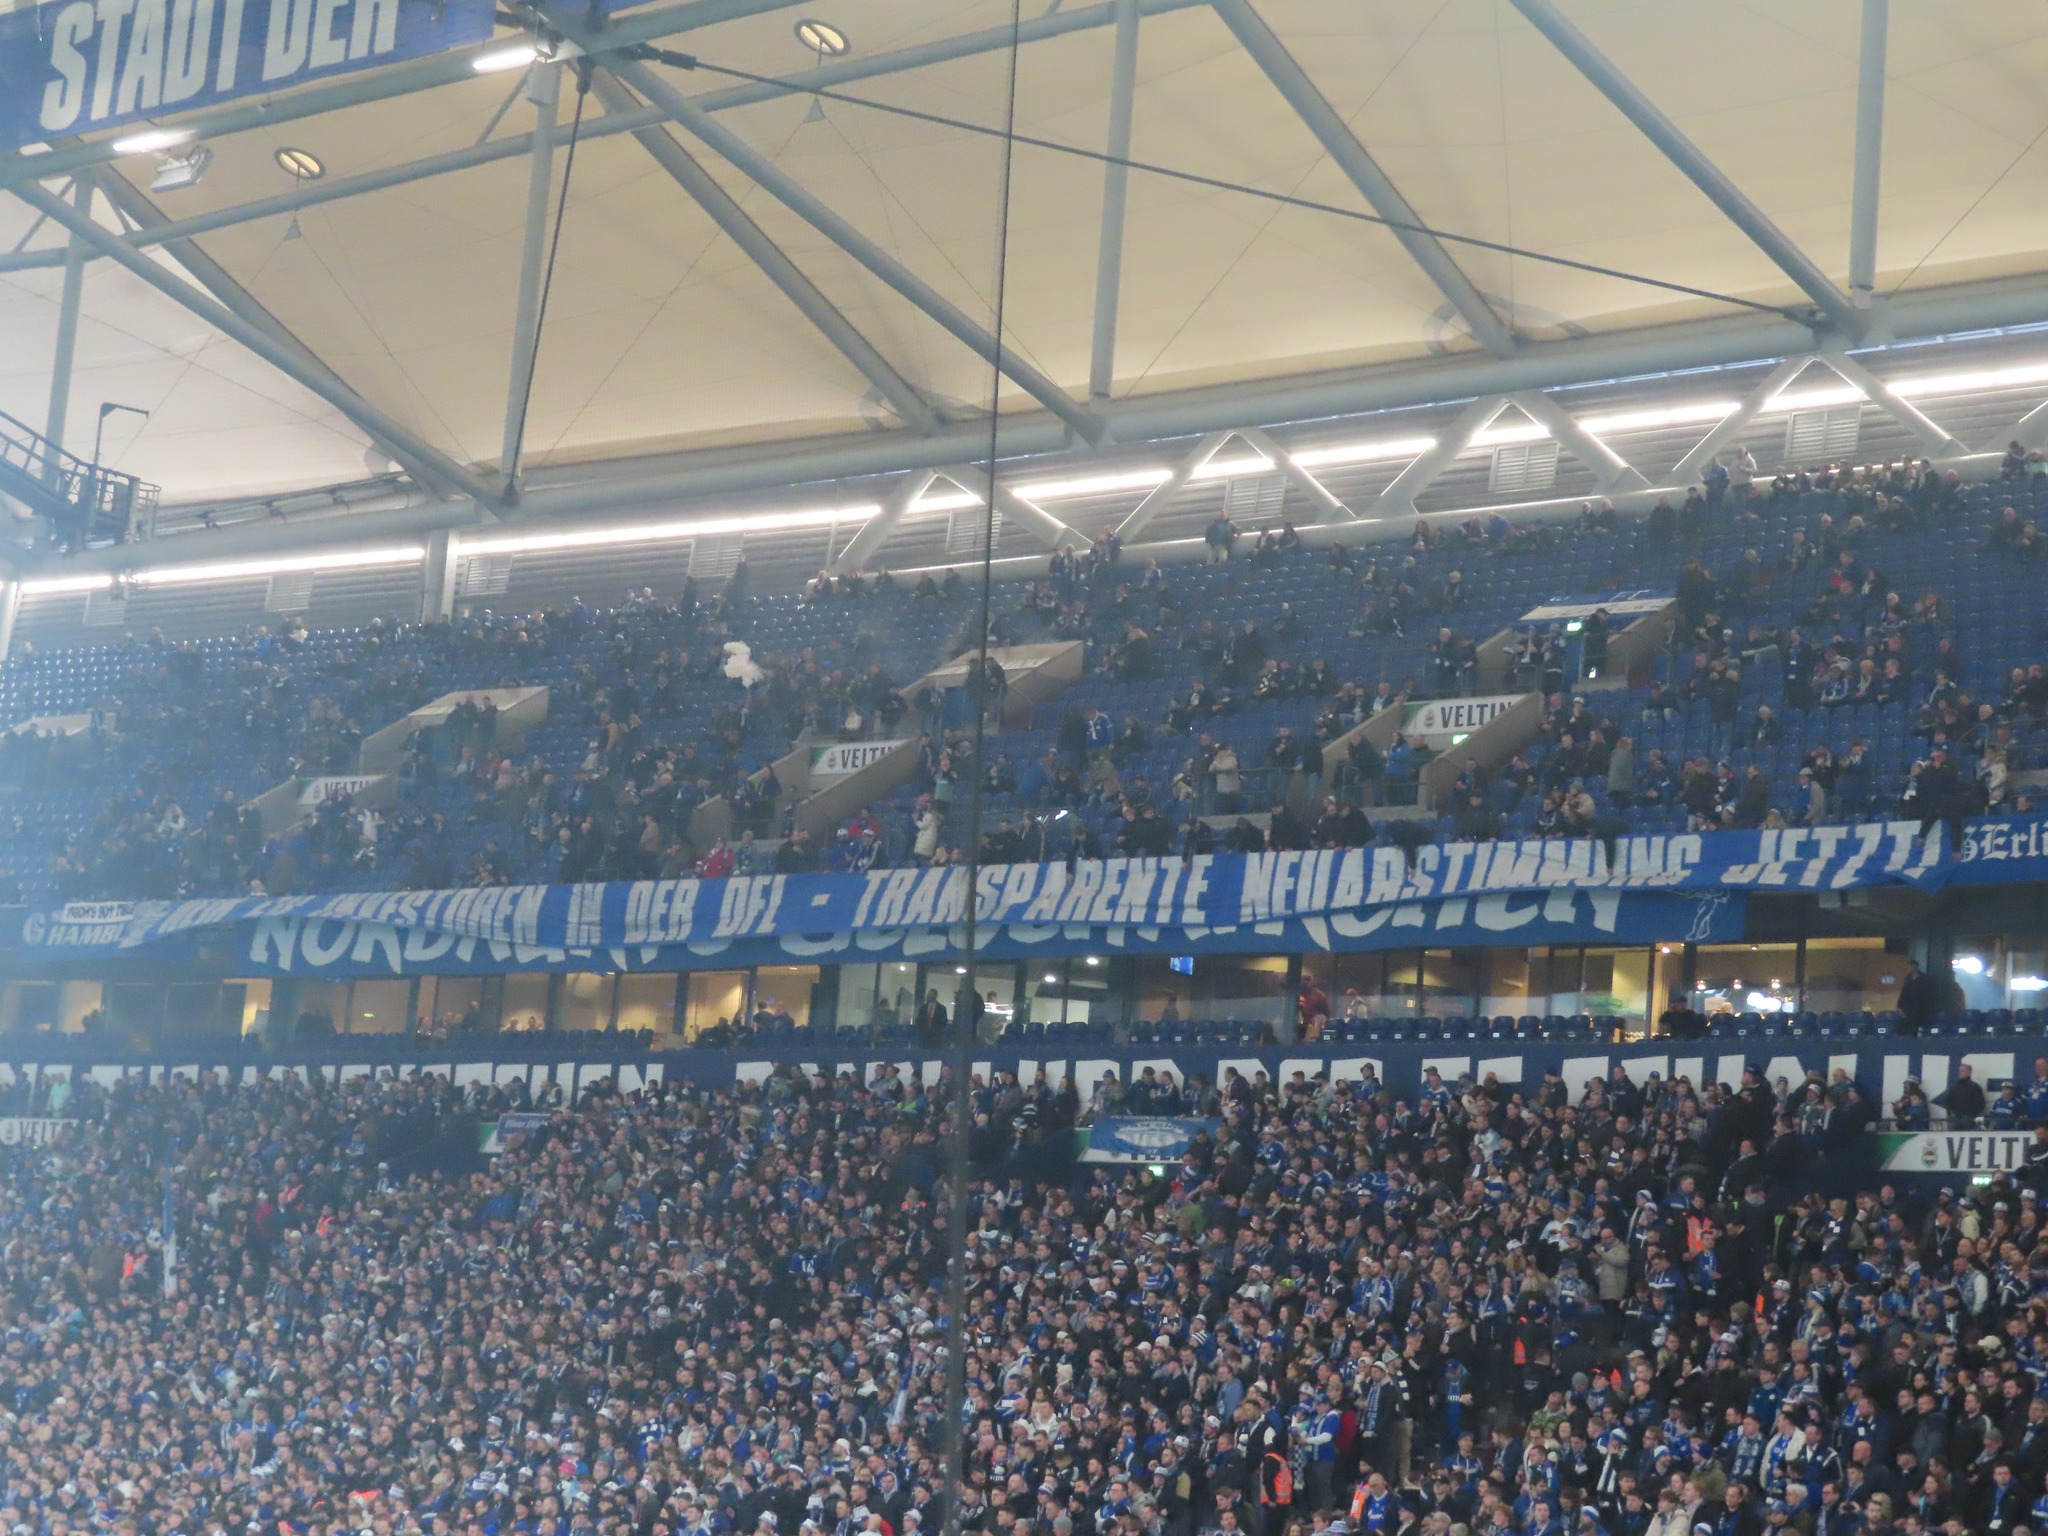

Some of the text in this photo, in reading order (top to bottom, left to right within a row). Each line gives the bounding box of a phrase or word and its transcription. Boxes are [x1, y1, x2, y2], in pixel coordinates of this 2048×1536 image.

[39, 0, 244, 131] STADT
[624, 879, 700, 944] DER
[711, 874, 788, 938] DFL
[851, 853, 1214, 928] TRANSPARENTE
